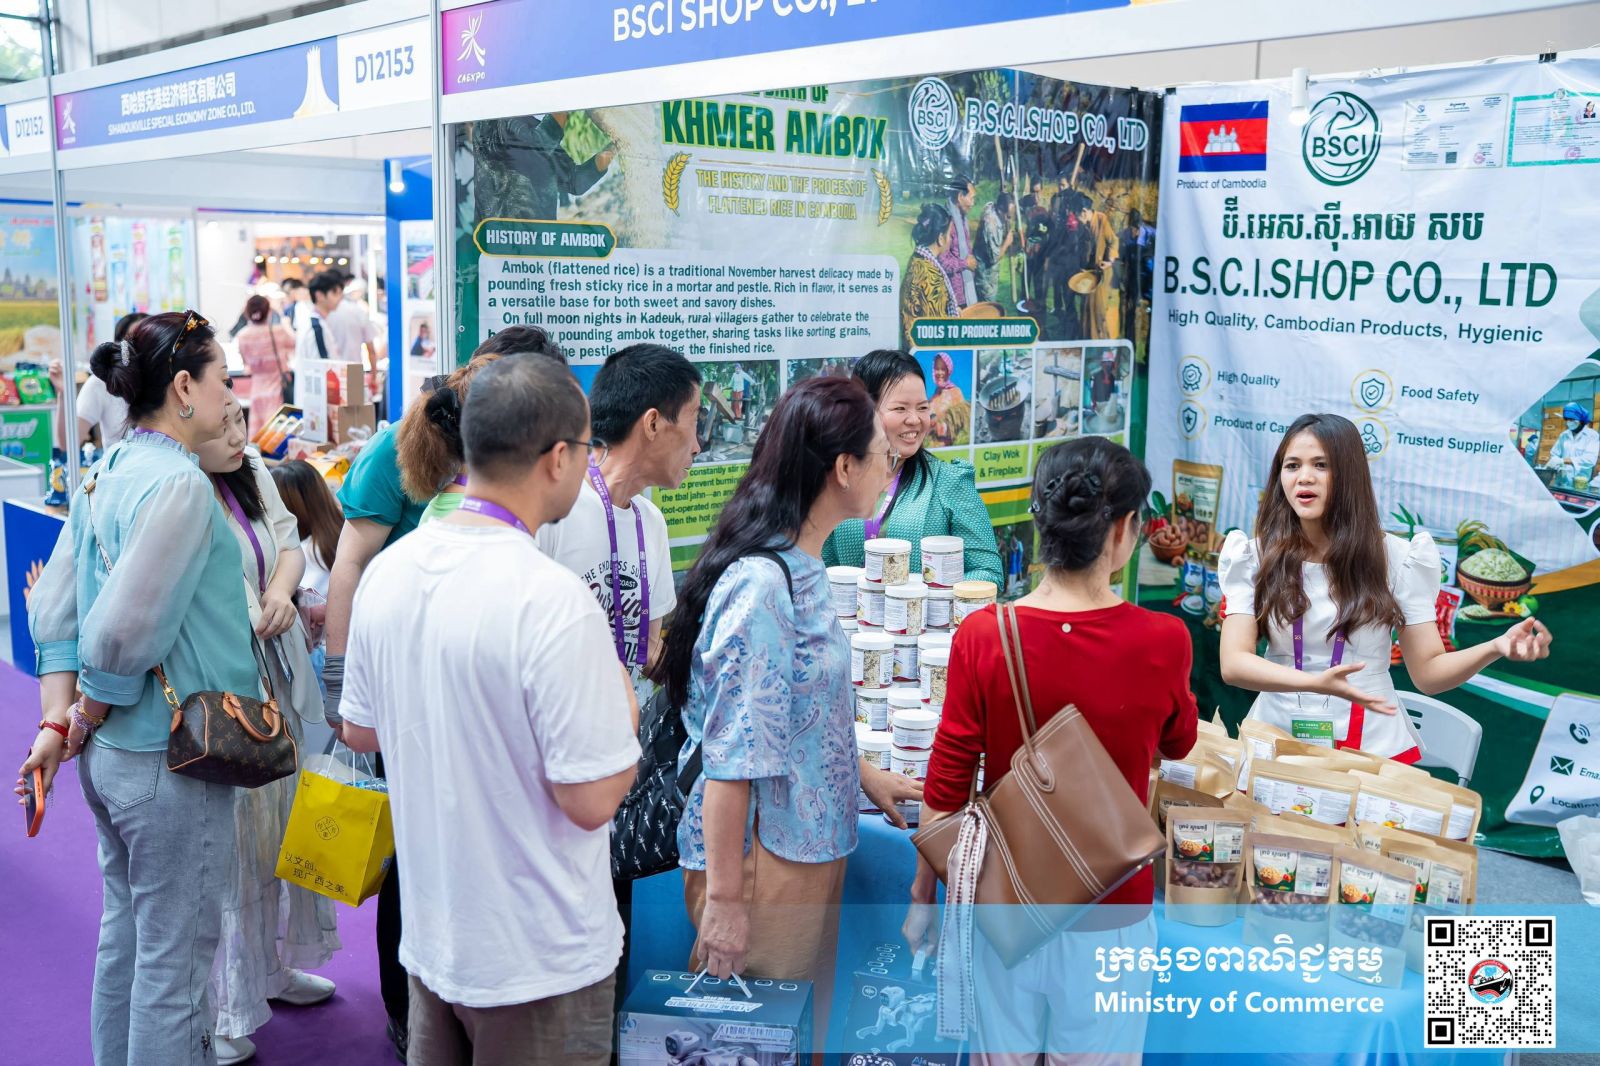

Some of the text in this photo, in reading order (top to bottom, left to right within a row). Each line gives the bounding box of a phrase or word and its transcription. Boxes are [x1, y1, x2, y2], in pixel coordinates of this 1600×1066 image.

[613, 0, 673, 42] BSCI
[680, 0, 763, 32] SHOP
[355, 46, 414, 83] D12153
[457, 71, 486, 84] CAEXPO
[176, 110, 207, 125] ECONOMY
[207, 106, 226, 121] ZONE
[917, 110, 947, 128] BSCI
[15, 115, 44, 138] D12152
[662, 100, 888, 160] KHMER AMBOK
[965, 98, 1149, 154] B.S.C.I.SHOP CO., LTD
[1311, 135, 1366, 158] BSCI
[696, 169, 719, 188] THE
[720, 171, 765, 191] HISTORY
[767, 175, 789, 192] AND
[789, 176, 810, 194] THE
[811, 178, 854, 197] PROCESS
[1176, 177, 1267, 190] Product of Cambodia
[708, 196, 857, 220] FLATTENED RICE IN CAMBODIA
[486, 230, 606, 248] HISTORY OF AMBOK
[501, 261, 894, 282] Ambok (flattened rice) is a traditional November harvest delicacy made by
[488, 279, 892, 295] pounding fresh sticky rice in a mortar and pestle. Rich in flavor, it serves as
[1164, 255, 1558, 314] B.S.C.I.SHOP CO., LTD
[488, 296, 776, 310] a versatile base for both sweet and savory dishes.
[503, 312, 870, 326] On full moon nights in Kadeuk, rural villagers gather to celebrate the
[1167, 309, 1543, 343] High Quality, Cambodian Products, Hygienic
[559, 326, 871, 342] pounding ambok together, sharing tasks like sorting grains,
[917, 325, 1031, 339] TOOLS TO PRODUCE AMBOK
[561, 346, 575, 357] he
[689, 344, 705, 354] the
[709, 343, 750, 354] finished
[753, 343, 775, 353] rice.
[1217, 371, 1280, 388] High Quality
[1401, 385, 1480, 404] Food Safety
[1214, 415, 1253, 430] Product
[1255, 421, 1266, 431] of
[1397, 432, 1504, 454] Trusted Supplier
[983, 449, 1020, 464] Clay Wok
[979, 464, 1023, 478] & Fireplace
[687, 480, 714, 490] prevent
[662, 493, 673, 502] the
[686, 515, 697, 524] the
[1579, 767, 1600, 780] Ema
